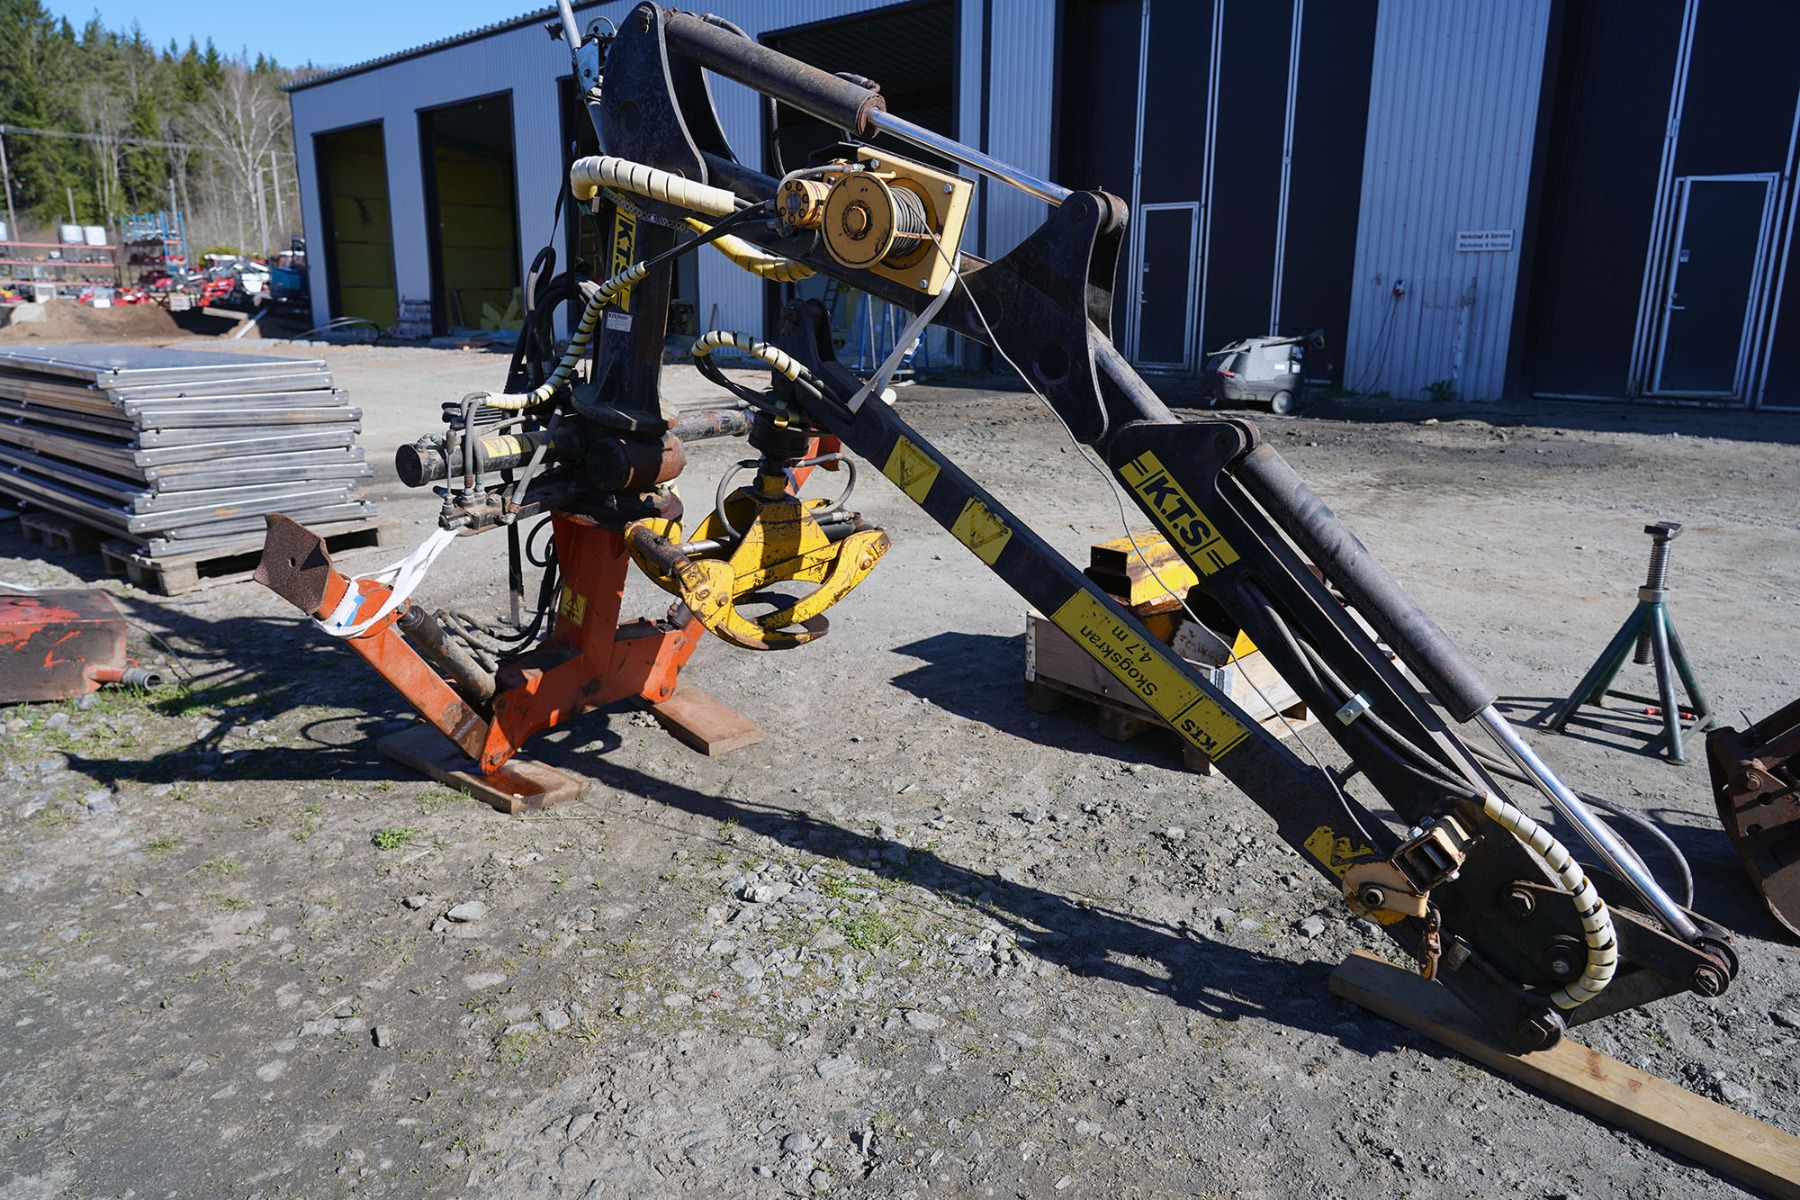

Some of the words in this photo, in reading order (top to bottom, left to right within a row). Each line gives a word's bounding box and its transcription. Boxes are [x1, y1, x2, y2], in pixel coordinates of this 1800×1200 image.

[1111, 625, 1128, 642] m
[1080, 625, 1158, 697] Skogskran
[1125, 643, 1153, 663] 4,7
